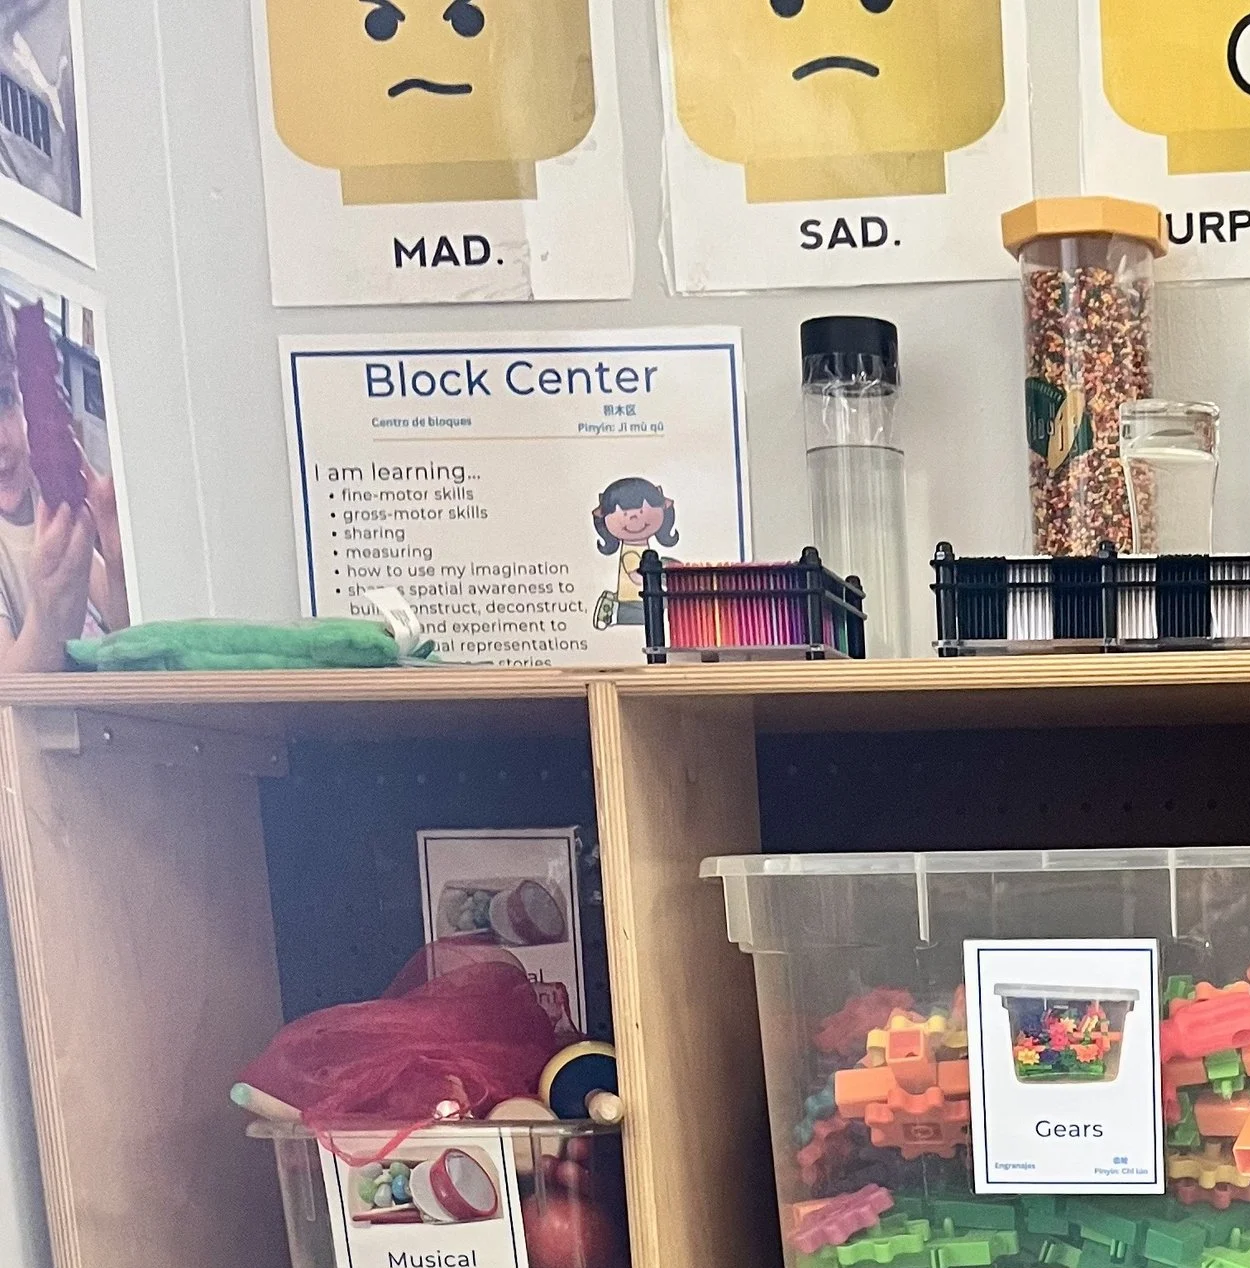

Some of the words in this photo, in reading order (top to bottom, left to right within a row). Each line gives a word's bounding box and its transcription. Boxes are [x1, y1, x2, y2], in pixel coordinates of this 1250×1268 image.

[800, 216, 901, 250] SAD.
[393, 235, 504, 268] MAD.
[366, 360, 491, 398] Block
[505, 360, 658, 397] Center
[372, 417, 409, 428] Centro
[412, 416, 425, 427] de
[428, 416, 472, 428] bloques
[578, 422, 615, 435] Pinyin:
[314, 463, 319, 481] I
[328, 467, 363, 481] am
[372, 461, 481, 484] learning...
[342, 488, 429, 501] fine-motor
[434, 487, 474, 501] skills
[343, 507, 443, 523] gross-motor
[449, 505, 488, 520] skills
[344, 527, 405, 542] sharing
[346, 546, 433, 561] measuring
[347, 564, 381, 577] how
[387, 565, 402, 577] to
[408, 567, 435, 577] use
[441, 566, 466, 580] my
[471, 562, 569, 578] imagination
[409, 582, 463, 599] spatial
[469, 582, 553, 595] awareness
[558, 581, 575, 594] to
[410, 602, 482, 617] onstruct,
[486, 601, 588, 615] deconstruct,
[452, 619, 545, 635] experiment
[551, 620, 567, 632] to
[461, 637, 588, 654] representations
[1035, 1120, 1104, 1138] Gears
[388, 1250, 477, 1268] Musical
